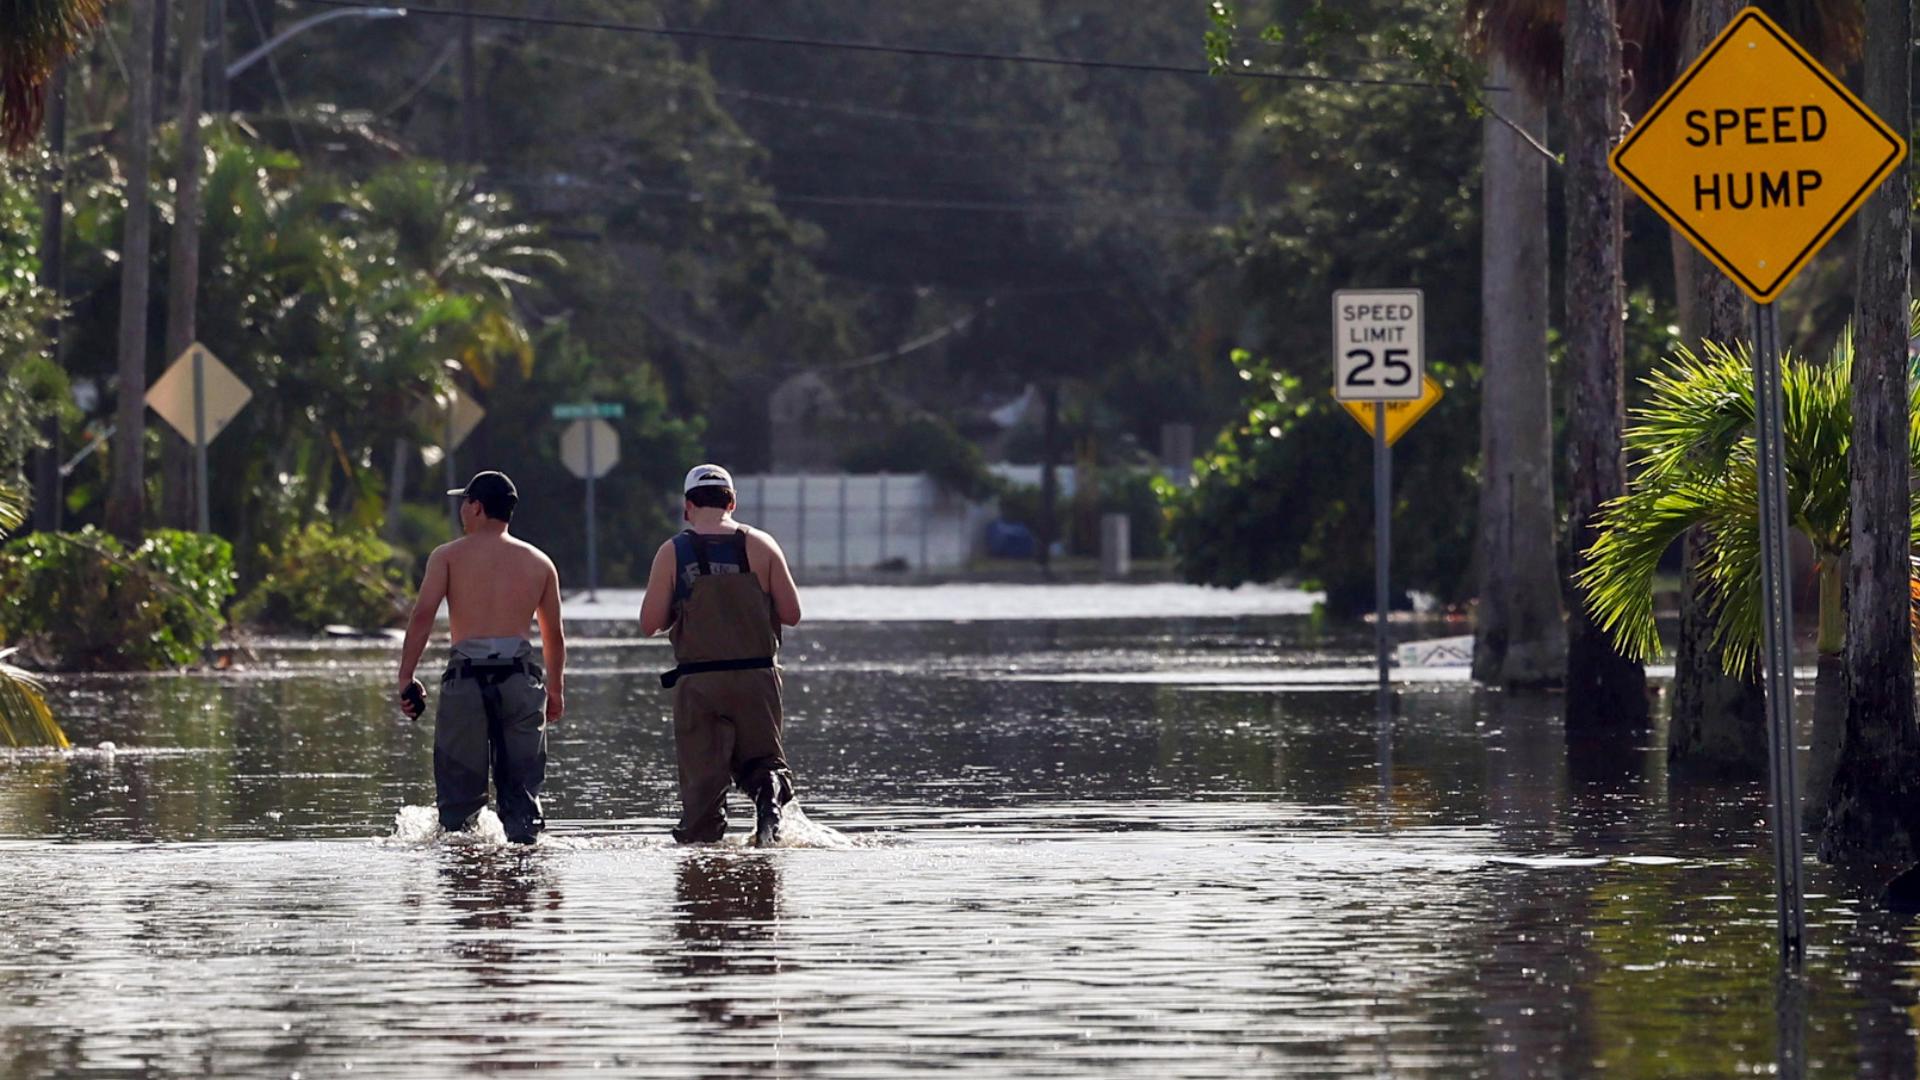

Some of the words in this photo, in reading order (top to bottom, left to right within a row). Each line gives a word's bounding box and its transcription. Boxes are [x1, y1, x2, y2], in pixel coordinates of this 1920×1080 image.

[1685, 105, 1827, 147] SPEED
[1694, 170, 1823, 211] HUMP
[1343, 304, 1414, 321] SPEED
[1350, 327, 1406, 343] LIMIT
[1346, 349, 1412, 386] 25
